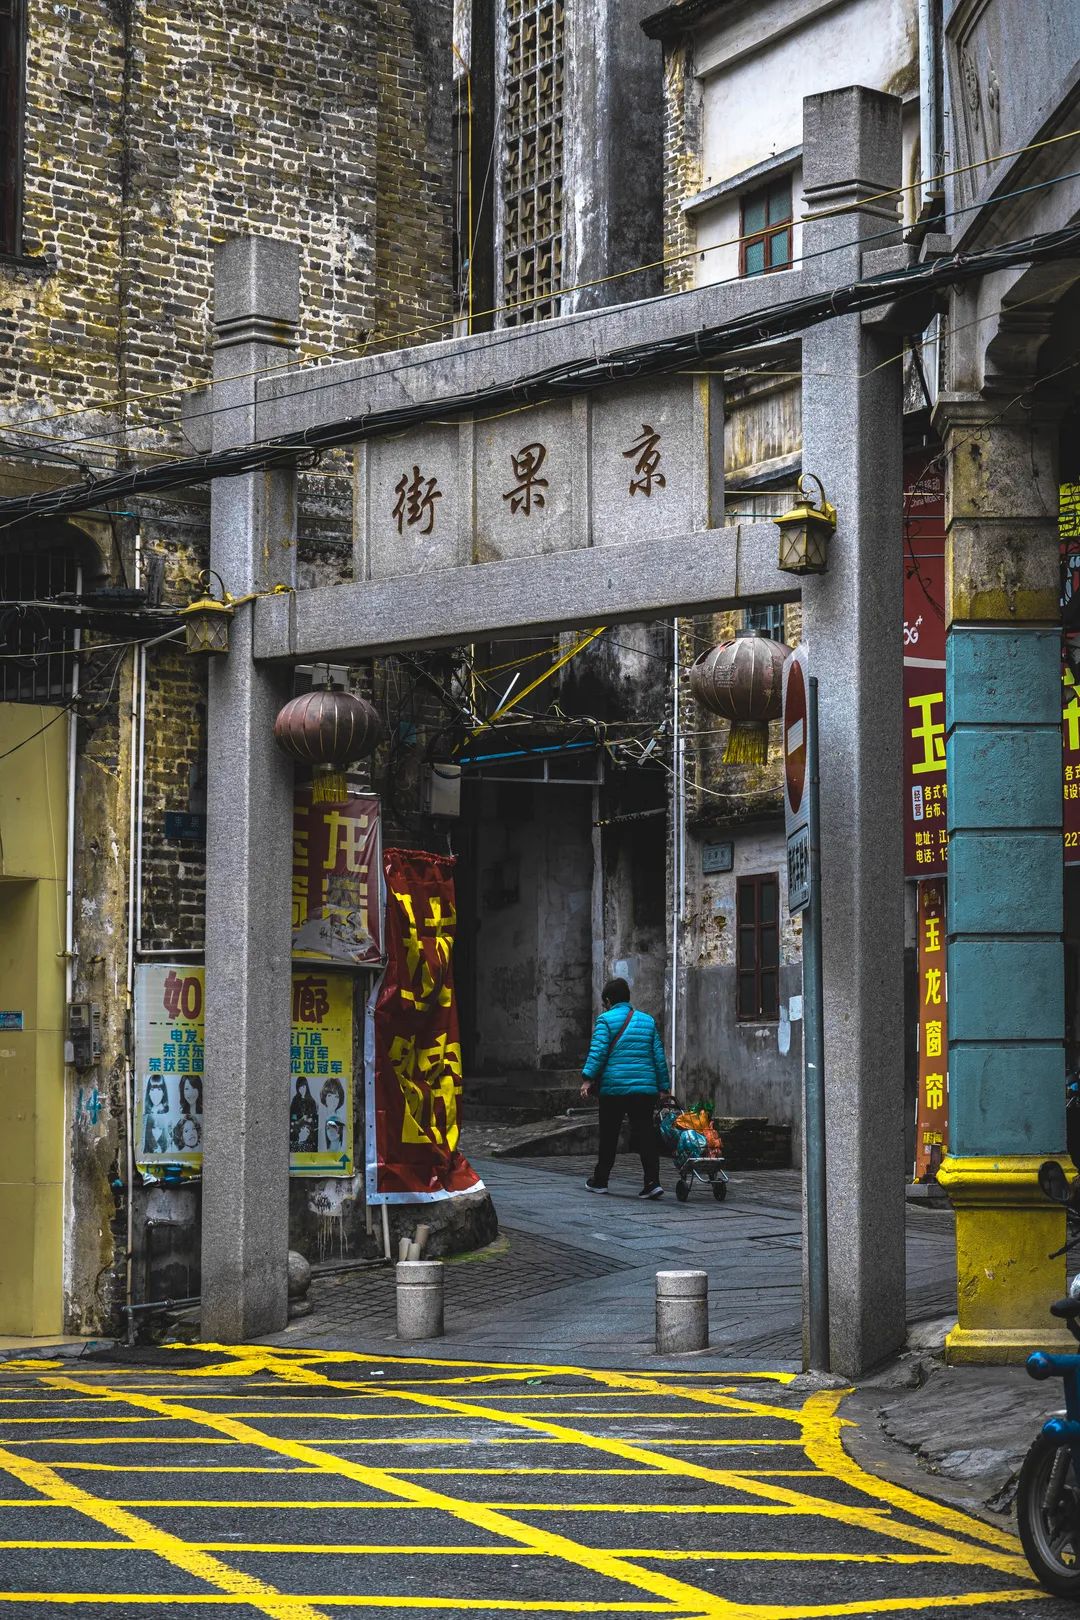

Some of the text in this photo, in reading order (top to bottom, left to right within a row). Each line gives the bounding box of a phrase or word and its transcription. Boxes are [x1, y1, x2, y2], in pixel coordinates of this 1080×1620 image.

[163, 970, 202, 1020] 如
[924, 917, 943, 1110] 玉龙窗帘
[149, 1058, 204, 1072] 荣获全国
